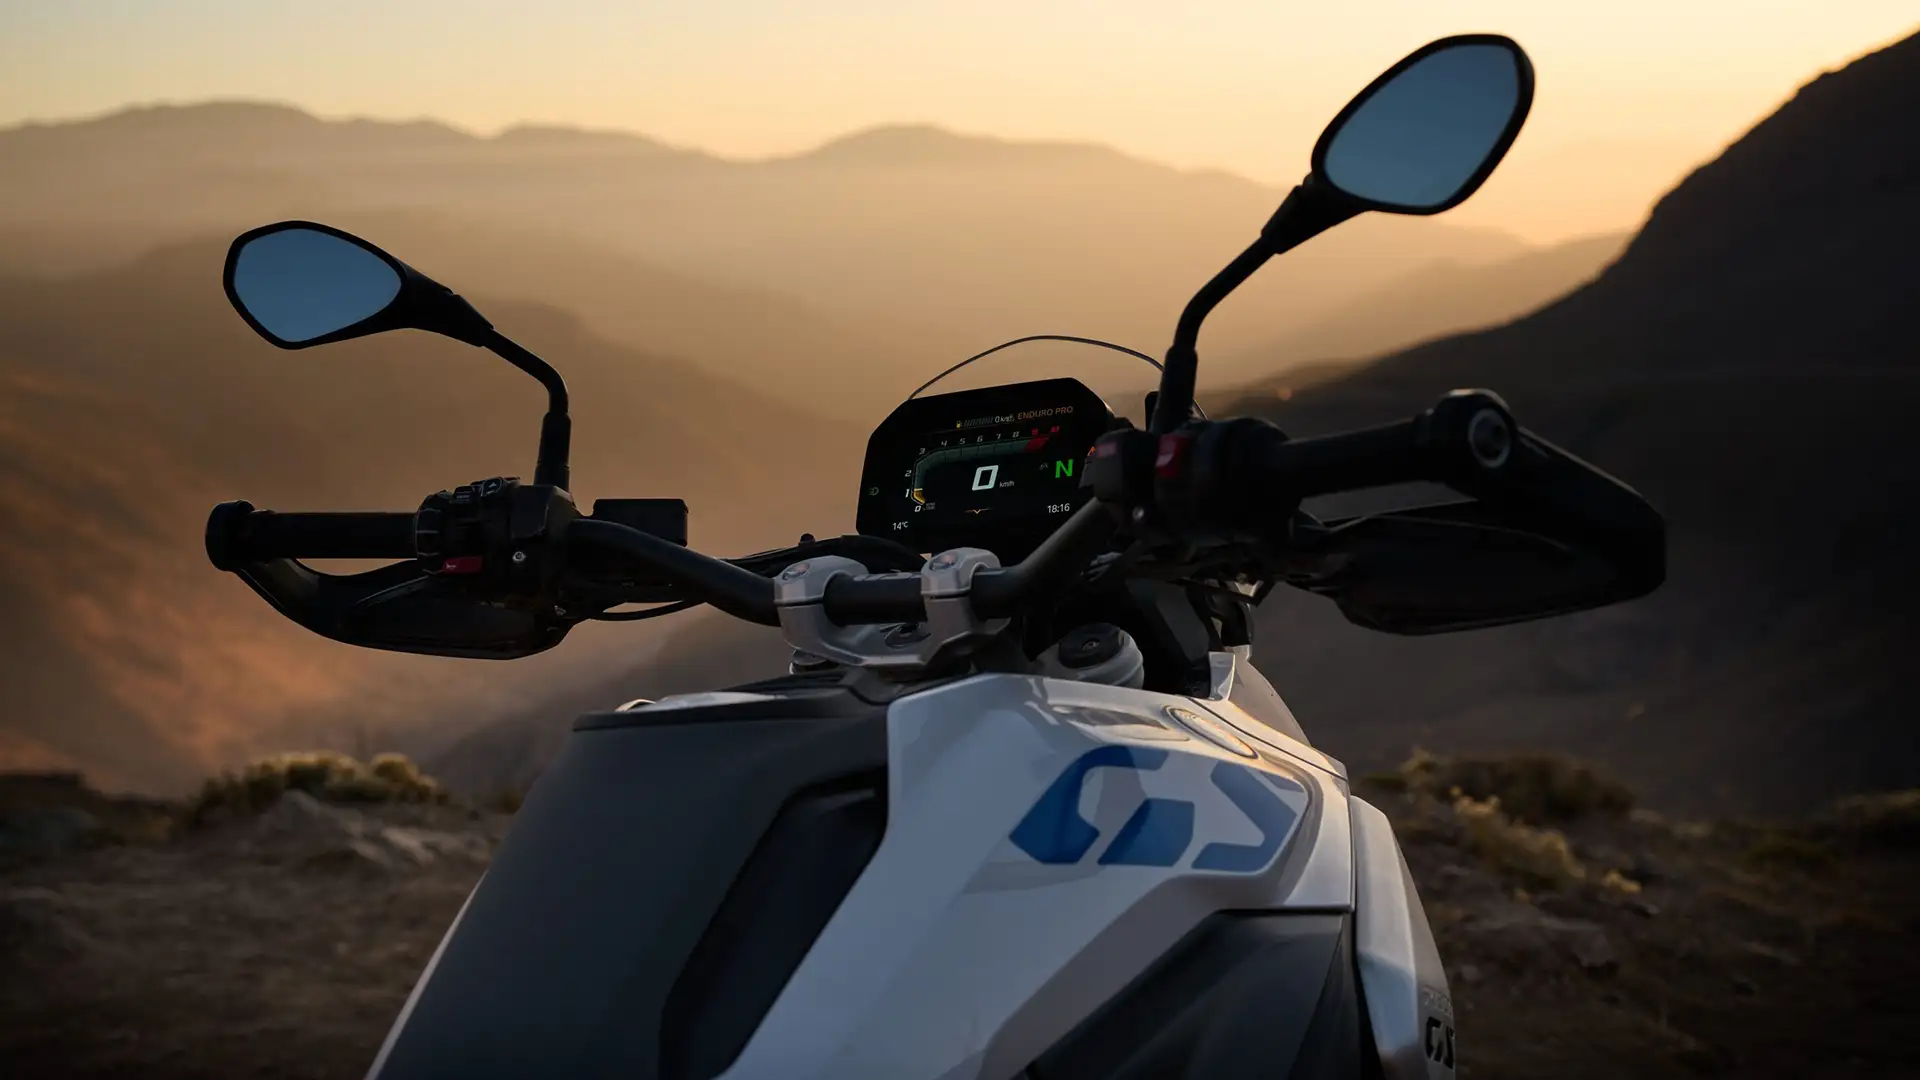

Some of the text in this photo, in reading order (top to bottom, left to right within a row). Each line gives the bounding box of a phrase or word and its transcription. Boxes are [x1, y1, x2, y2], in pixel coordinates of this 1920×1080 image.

[1017, 408, 1053, 420] ENDURO
[1055, 406, 1074, 415] PRO
[918, 447, 926, 455] 3
[958, 437, 966, 445] 5
[976, 435, 984, 443] 6
[904, 469, 912, 477] 2
[1054, 458, 1074, 479] N
[971, 464, 999, 491] 0
[905, 488, 910, 498] 1
[914, 505, 922, 513] 0
[1047, 502, 1071, 514] 18:16
[1008, 745, 1306, 872] GS
